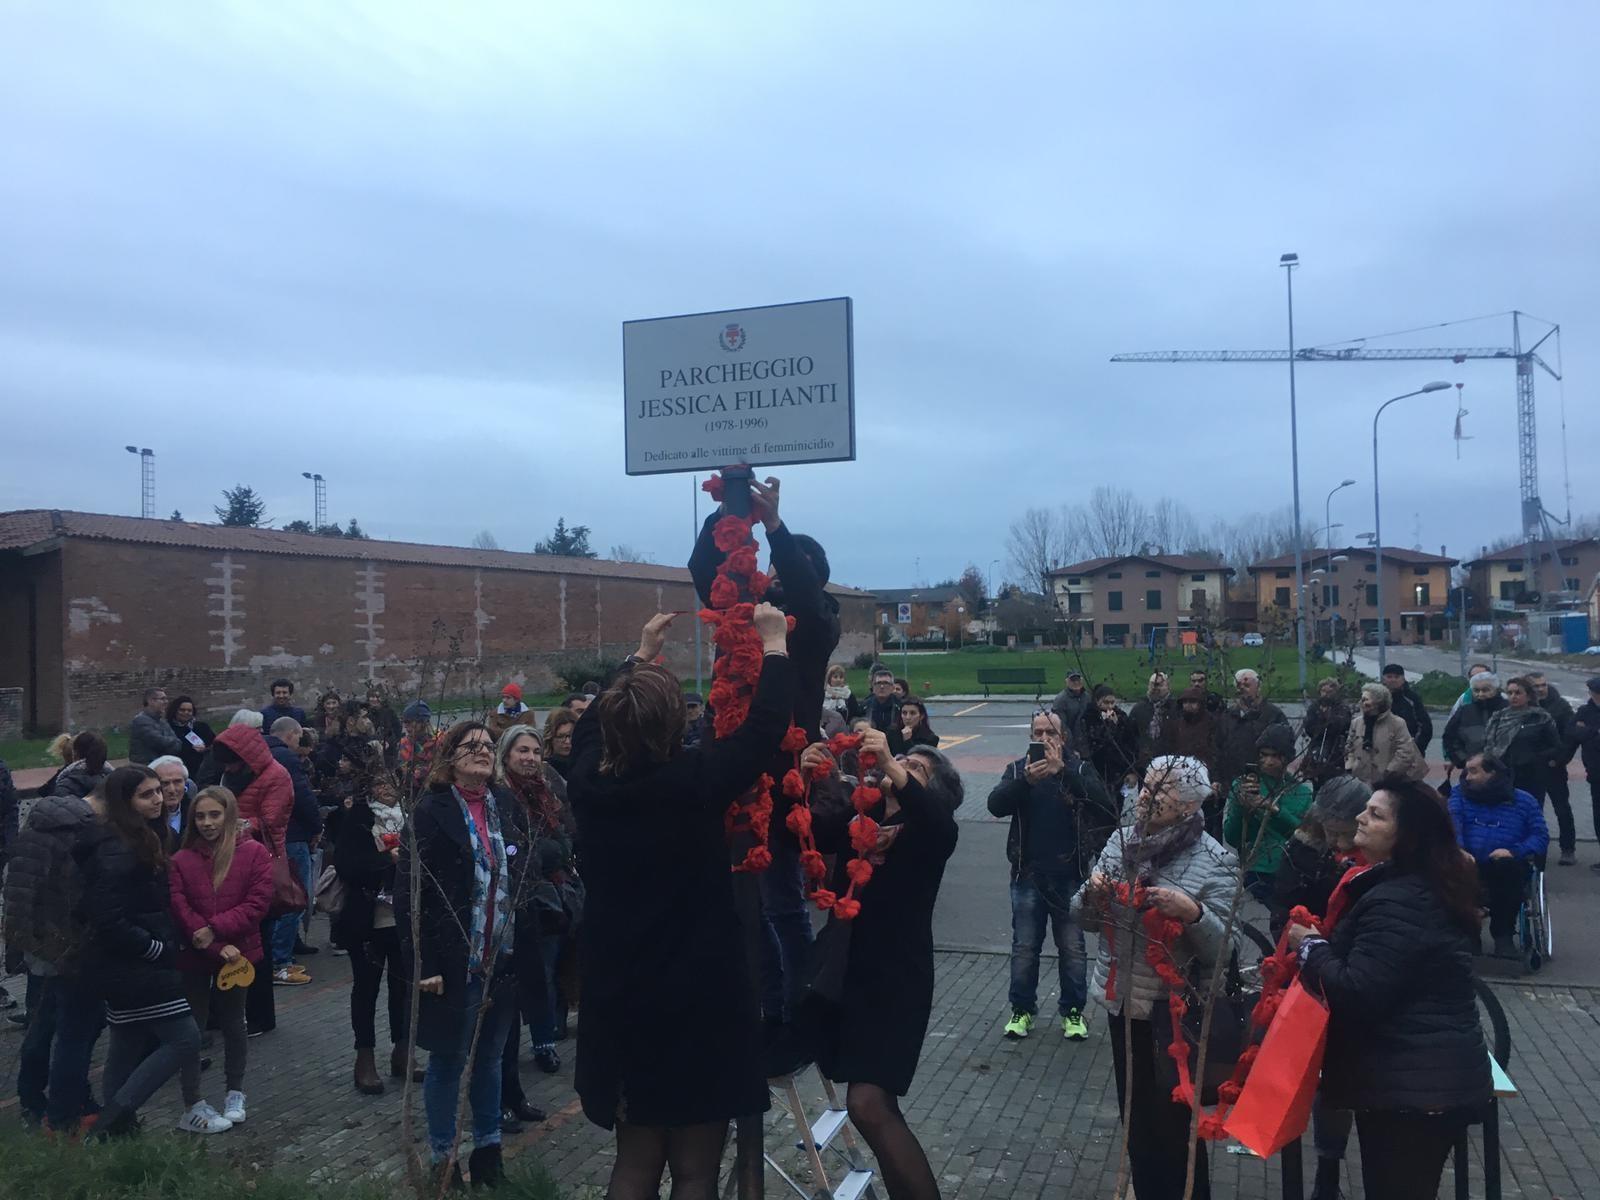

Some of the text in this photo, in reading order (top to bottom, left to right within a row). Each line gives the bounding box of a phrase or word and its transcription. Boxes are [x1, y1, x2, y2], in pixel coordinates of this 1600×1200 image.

[660, 356, 814, 388] PARCHEGGIO
[638, 383, 837, 419] JESSICA FILIANTI
[704, 418, 768, 433] (1978-1996)
[644, 439, 834, 462] Dedicato alle vittime di femminicidio
